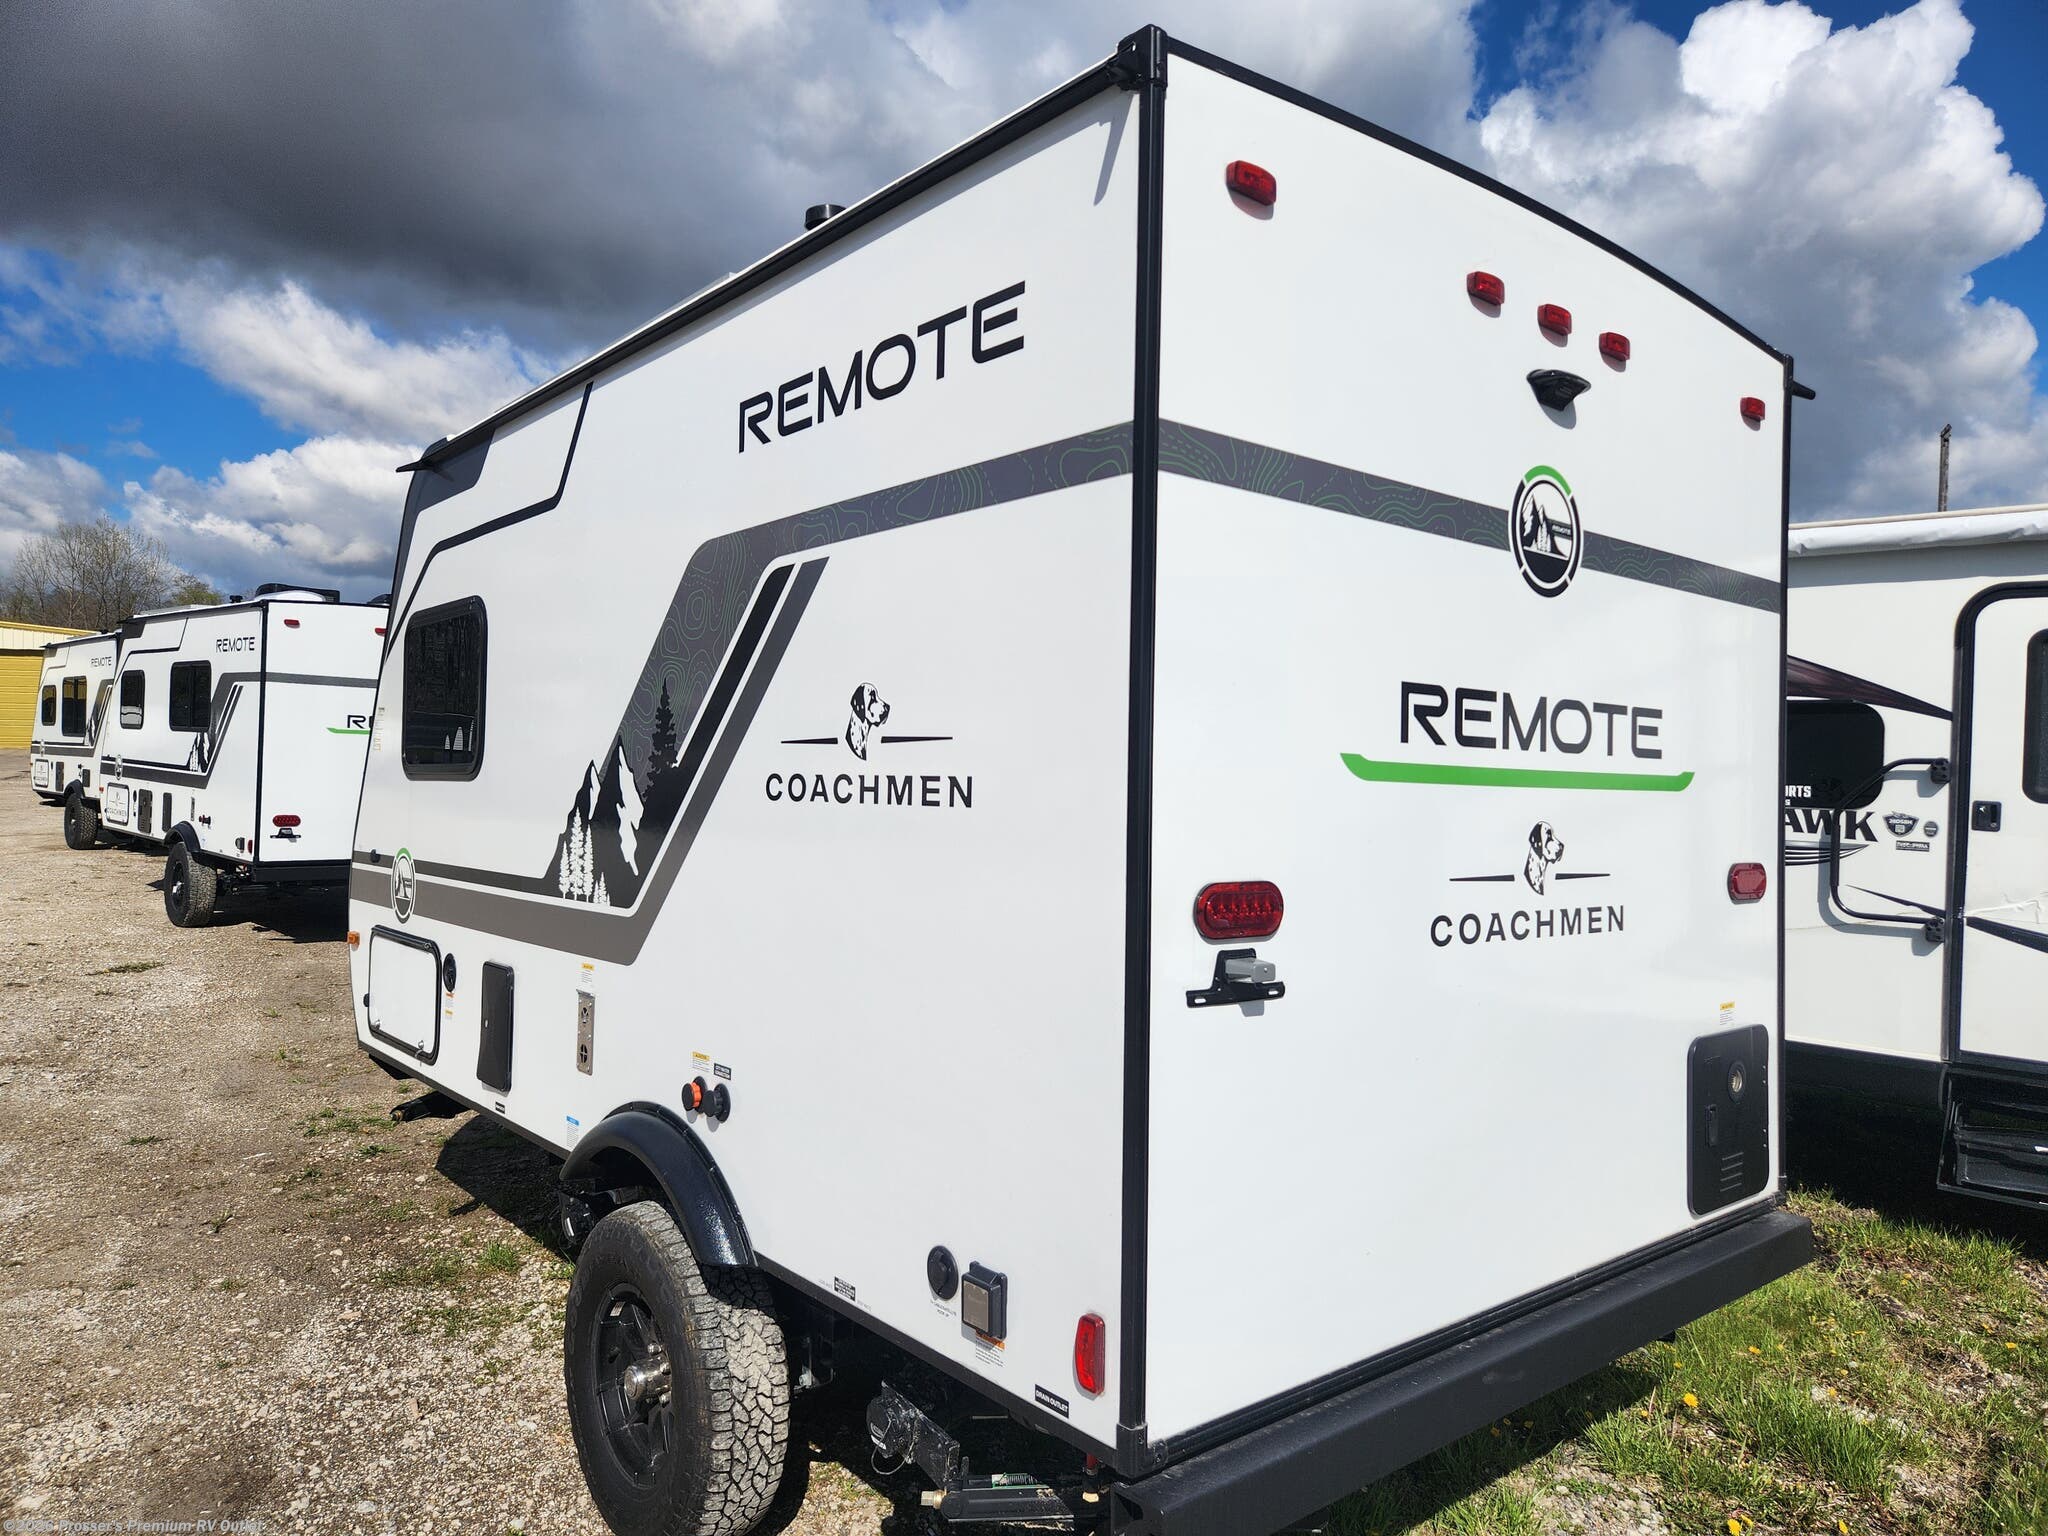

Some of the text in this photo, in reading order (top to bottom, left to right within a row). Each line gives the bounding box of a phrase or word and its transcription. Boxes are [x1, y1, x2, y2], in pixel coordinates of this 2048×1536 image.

[738, 280, 1026, 454] REMOTE
[215, 636, 255, 653] REMOTE
[1400, 681, 1663, 759] REMOTE
[765, 773, 973, 808] COACHMEN
[1430, 905, 1624, 947] COACHMEN
